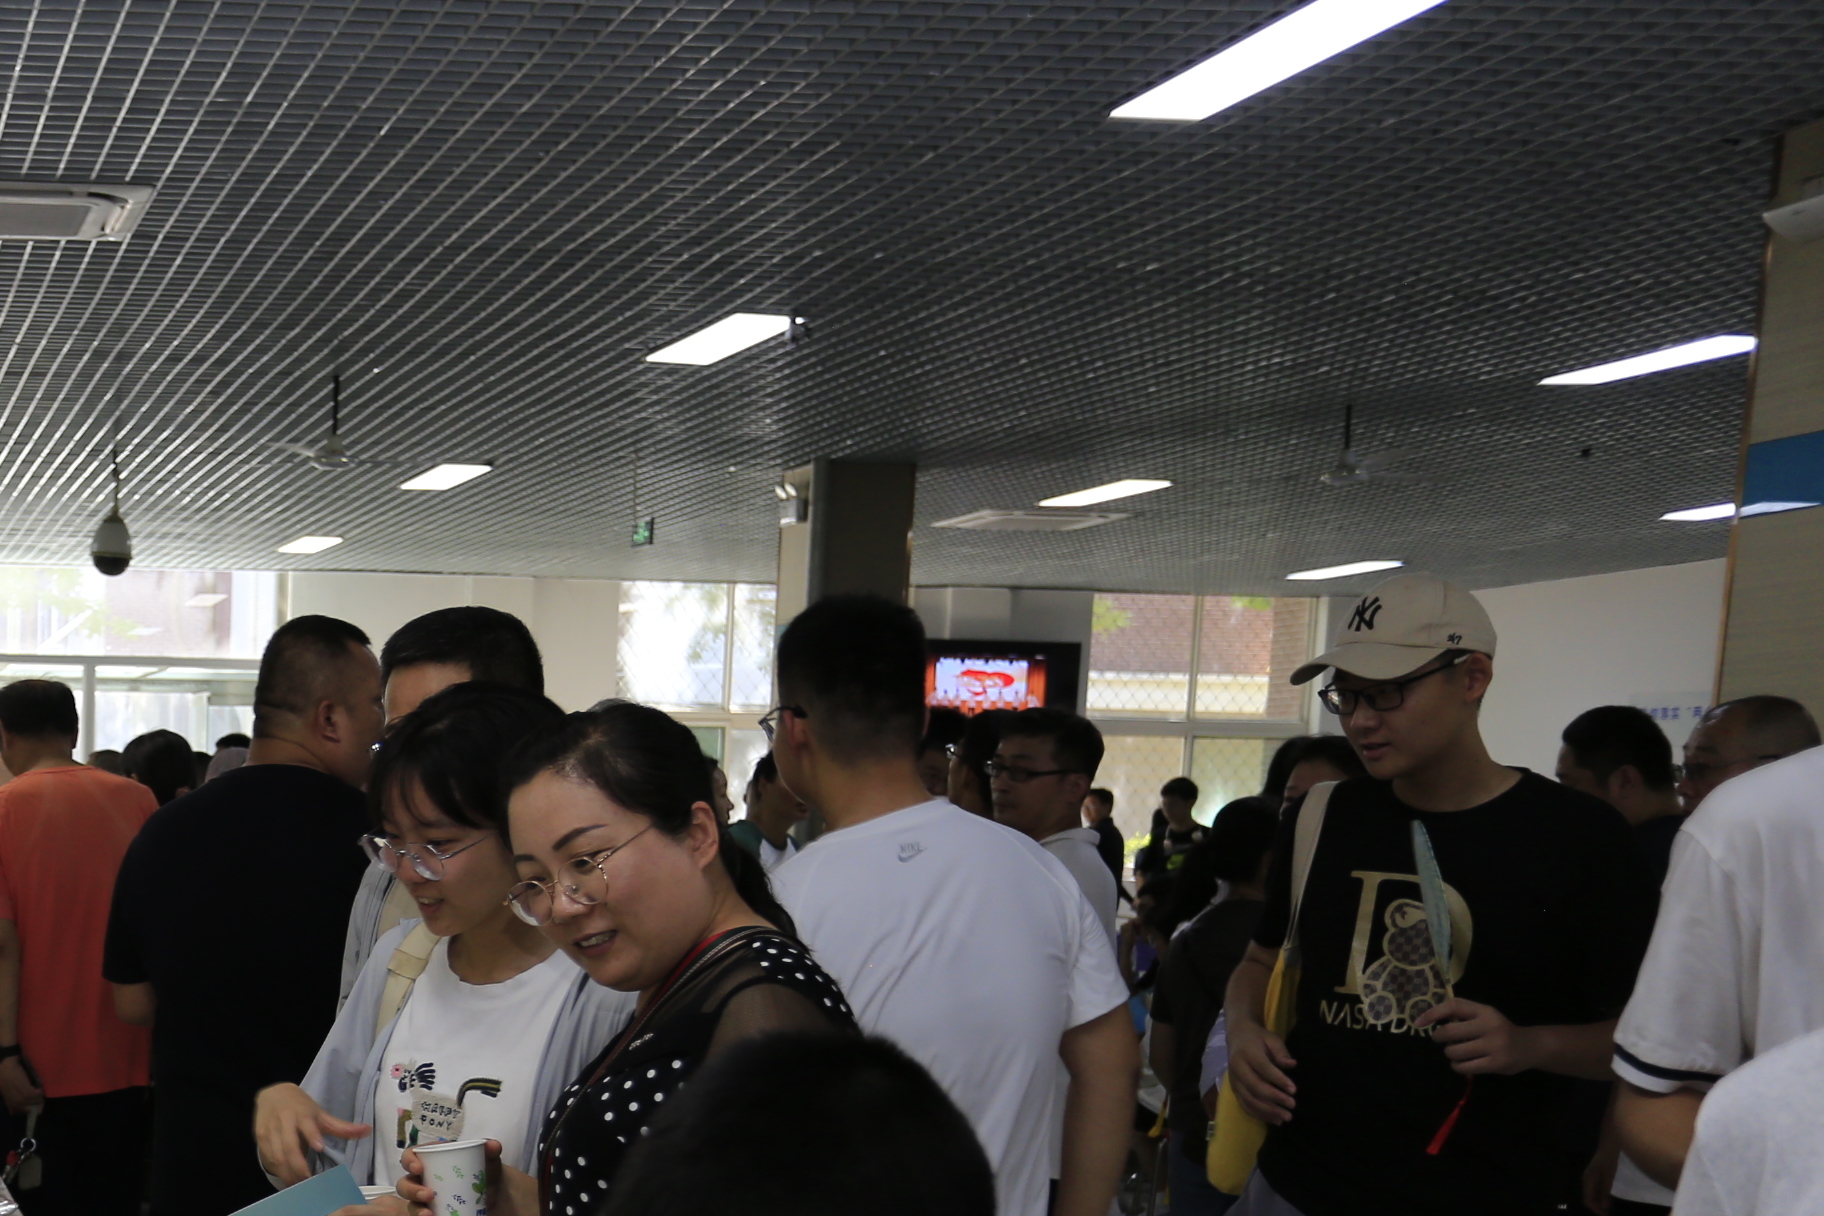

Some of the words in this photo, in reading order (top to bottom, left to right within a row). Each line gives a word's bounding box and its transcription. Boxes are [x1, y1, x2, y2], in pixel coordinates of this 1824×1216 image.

[1347, 595, 1382, 632] NY
[899, 841, 922, 854] NIKE
[421, 1101, 461, 1118] HAPPY
[419, 1114, 453, 1131] PONY
